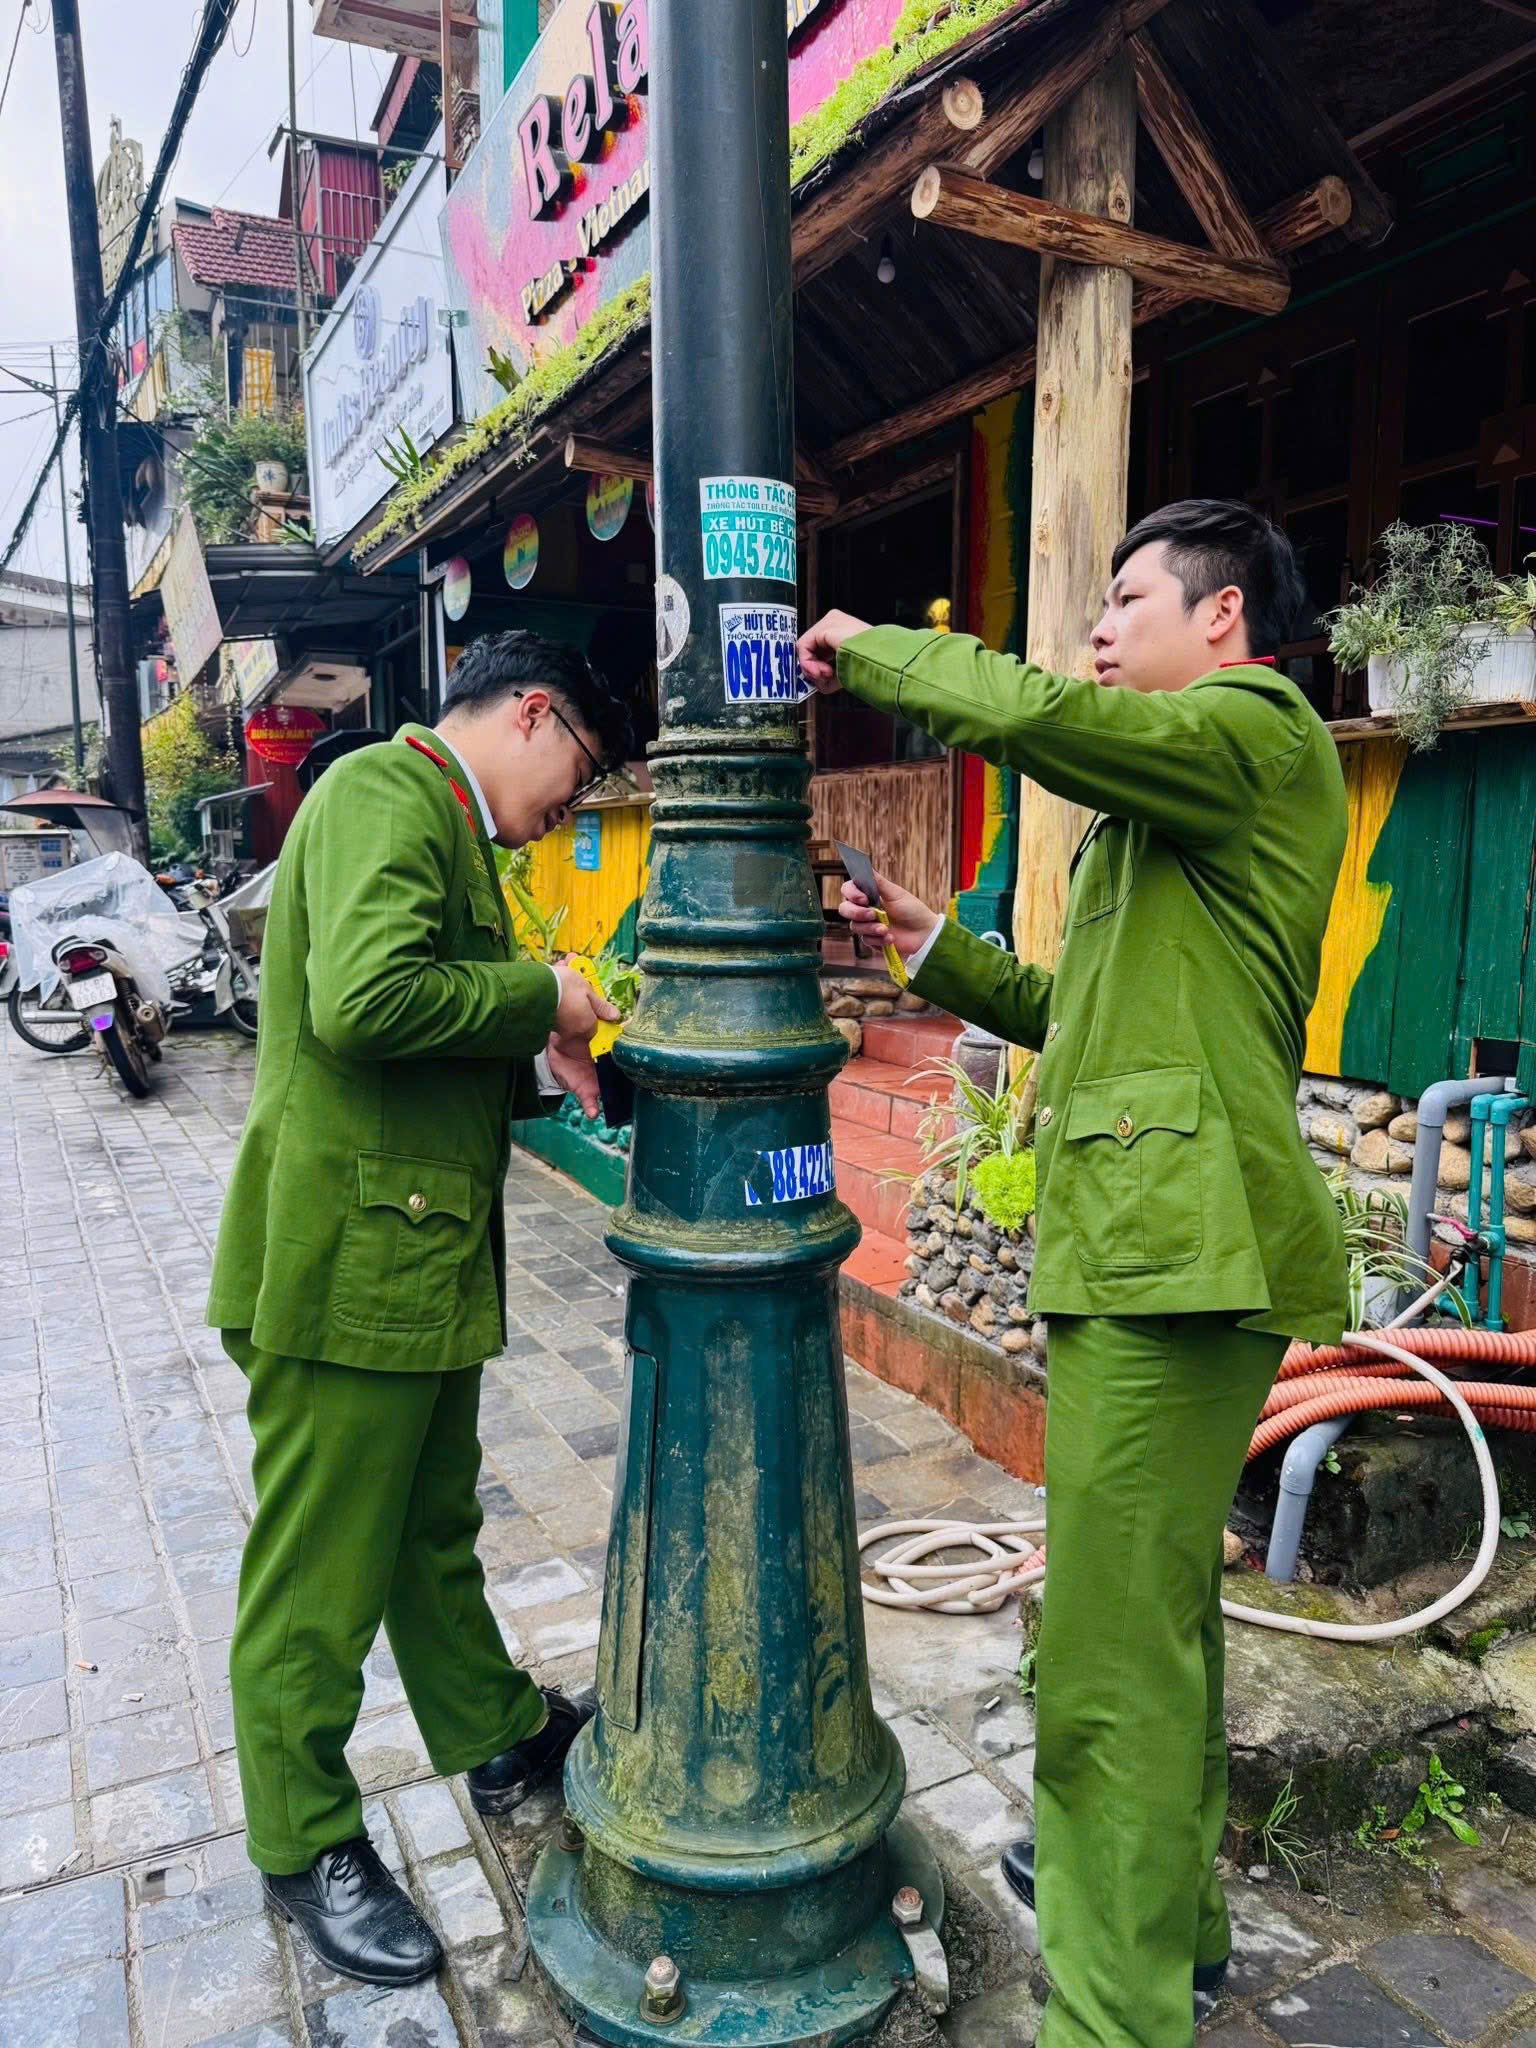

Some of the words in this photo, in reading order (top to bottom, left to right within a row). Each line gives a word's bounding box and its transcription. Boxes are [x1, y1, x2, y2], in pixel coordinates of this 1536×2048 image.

[521, 261, 565, 326] Pizza
[705, 479, 759, 499] THÔNG
[709, 517, 729, 531] XE
[735, 513, 766, 531] HÚT
[771, 517, 785, 534] BỂ
[744, 610, 764, 631] HÚT
[766, 610, 779, 631] BỂ
[727, 631, 754, 640] THÔNG
